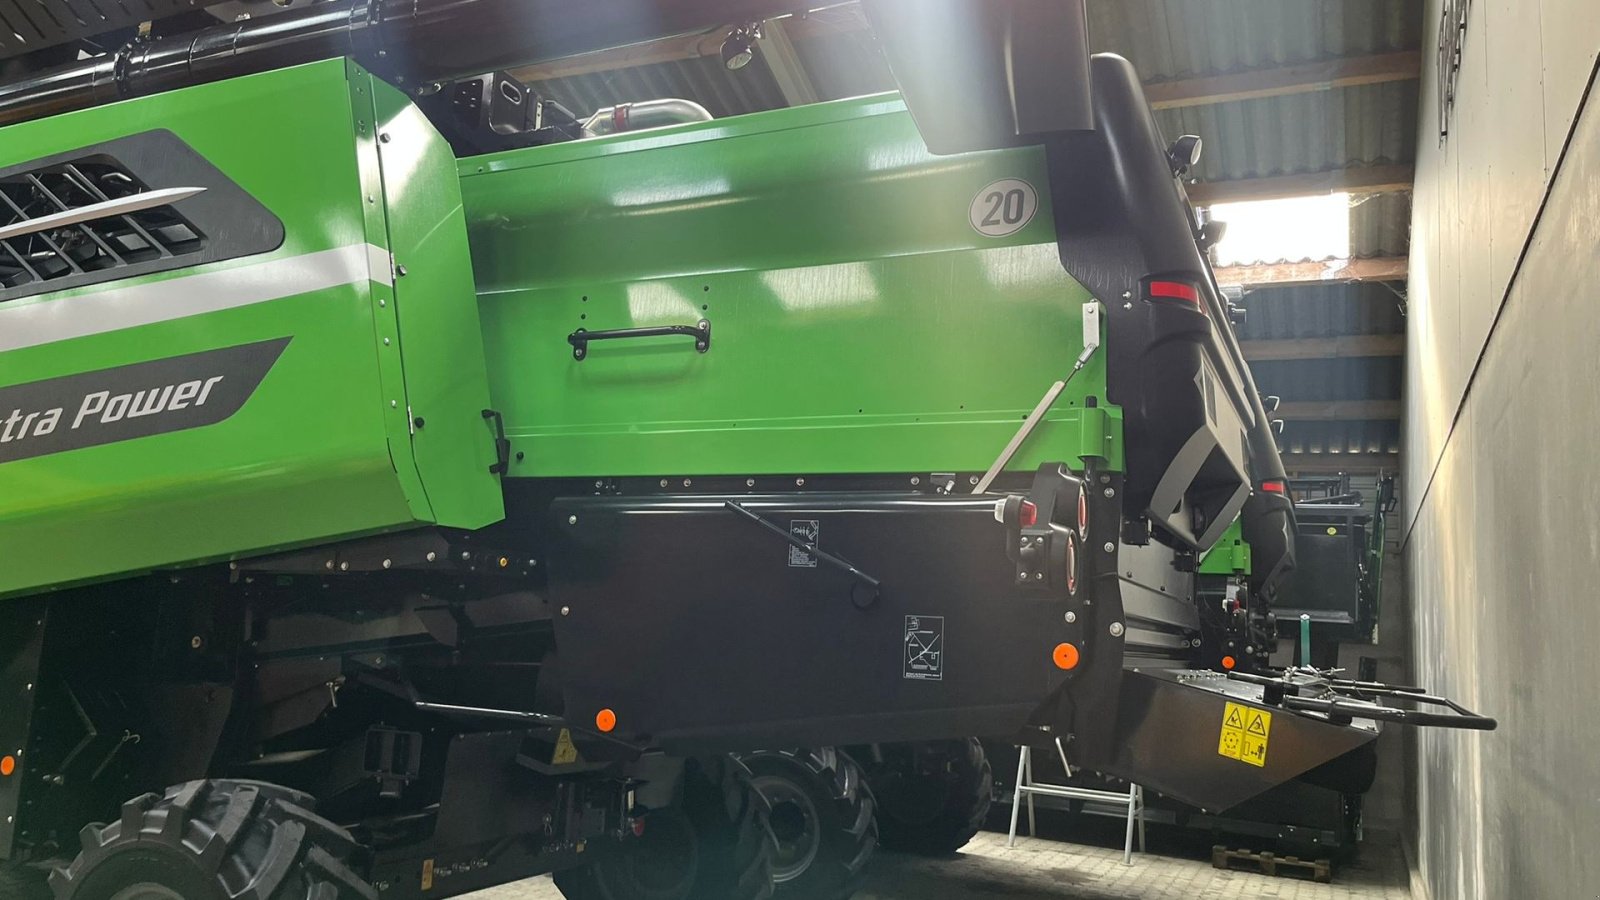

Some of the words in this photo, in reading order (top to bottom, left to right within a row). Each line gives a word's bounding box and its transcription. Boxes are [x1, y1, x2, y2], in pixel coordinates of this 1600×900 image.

[981, 188, 1025, 227] 20
[0, 408, 64, 443] tra
[71, 375, 224, 430] Power
